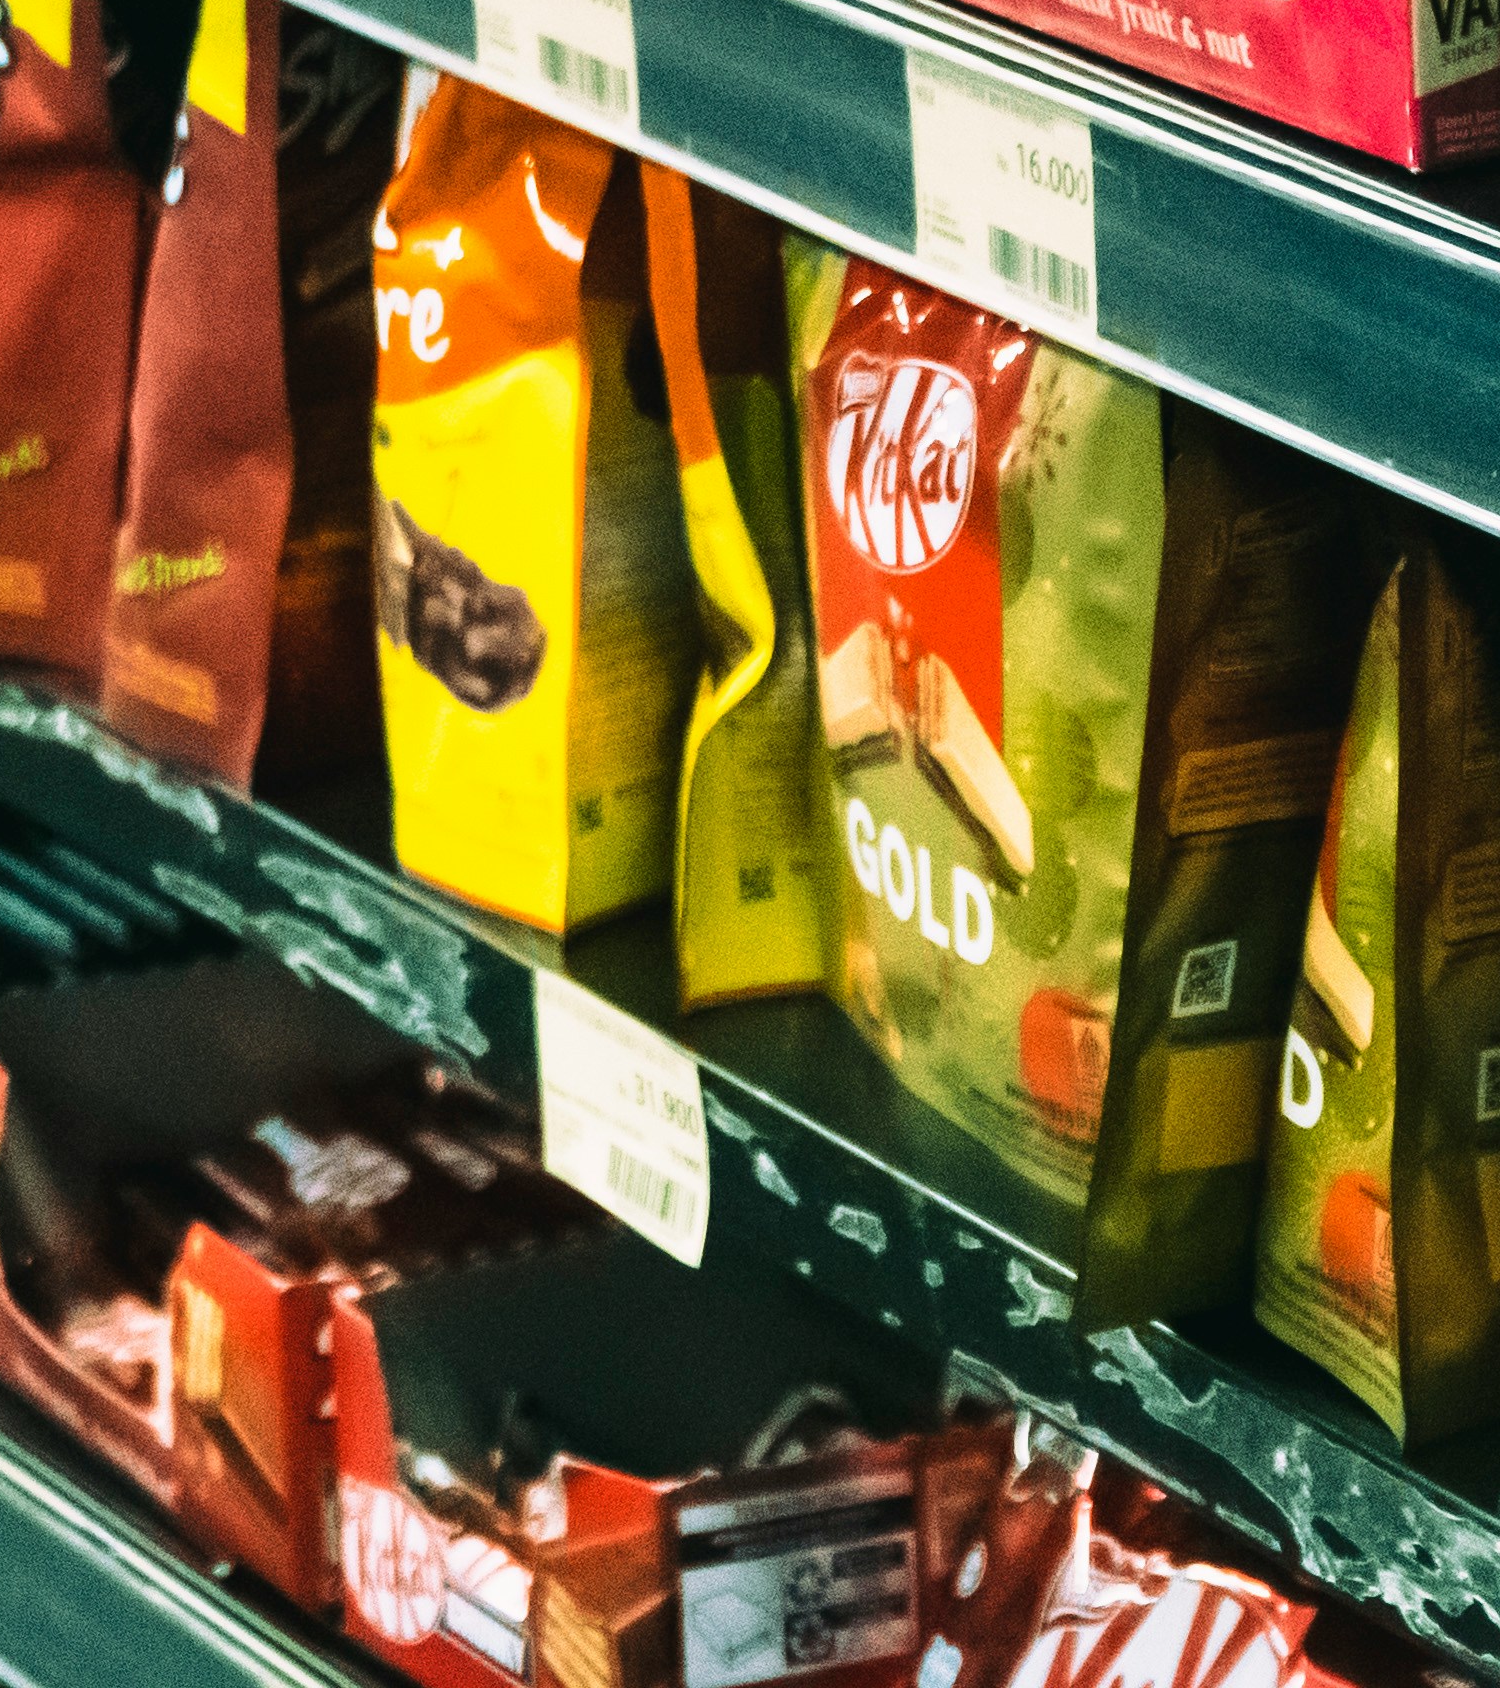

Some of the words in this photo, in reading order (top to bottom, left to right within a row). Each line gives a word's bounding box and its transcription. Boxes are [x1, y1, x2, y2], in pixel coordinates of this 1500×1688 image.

[1182, 16, 1202, 51] &
[1205, 24, 1254, 69] nut
[1016, 141, 1091, 209] 16.000
[844, 797, 994, 966] GOLD
